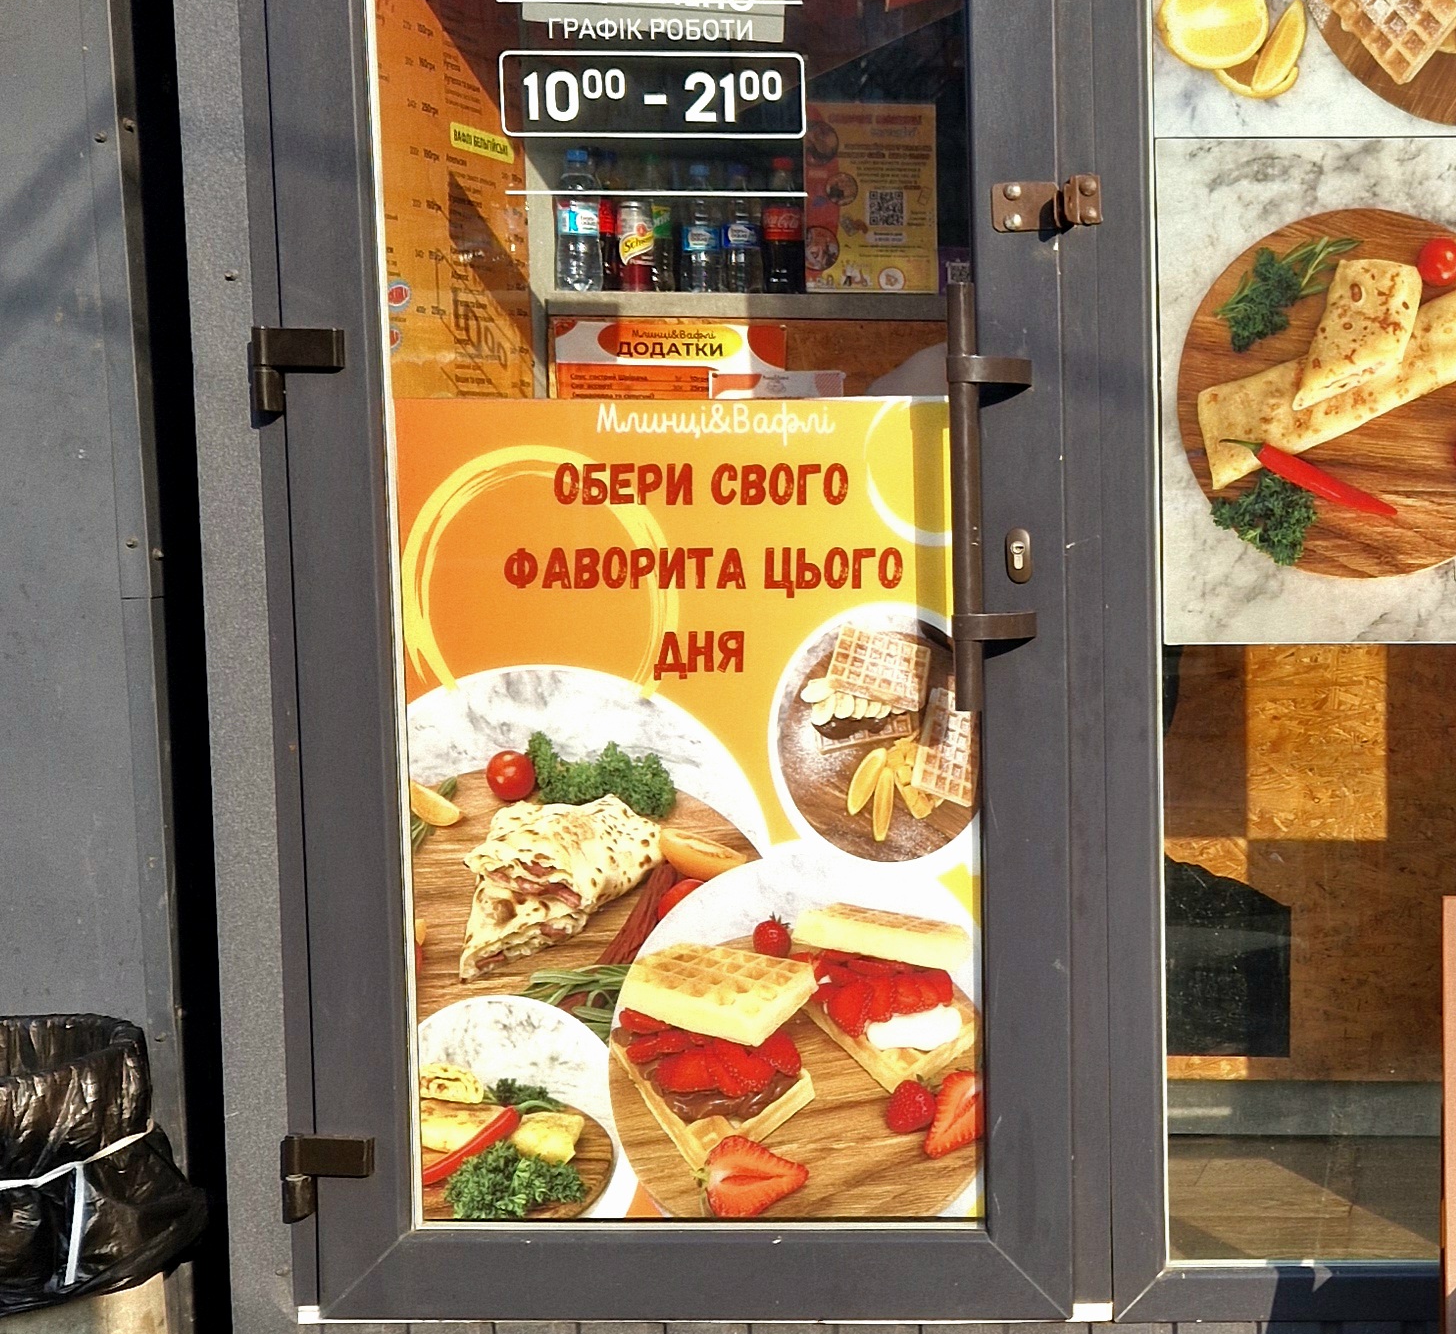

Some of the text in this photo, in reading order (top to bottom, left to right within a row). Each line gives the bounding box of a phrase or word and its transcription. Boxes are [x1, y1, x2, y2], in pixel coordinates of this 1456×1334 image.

[548, 17, 753, 42] ГРАФІК РОБОТИ
[616, 341, 723, 357] ДОДАТКИ
[553, 463, 849, 507] ОБЕРИ СВОГО
[504, 547, 904, 600] ФАВОРИТА ЦЬОГО
[653, 631, 745, 681] ДНЯ
